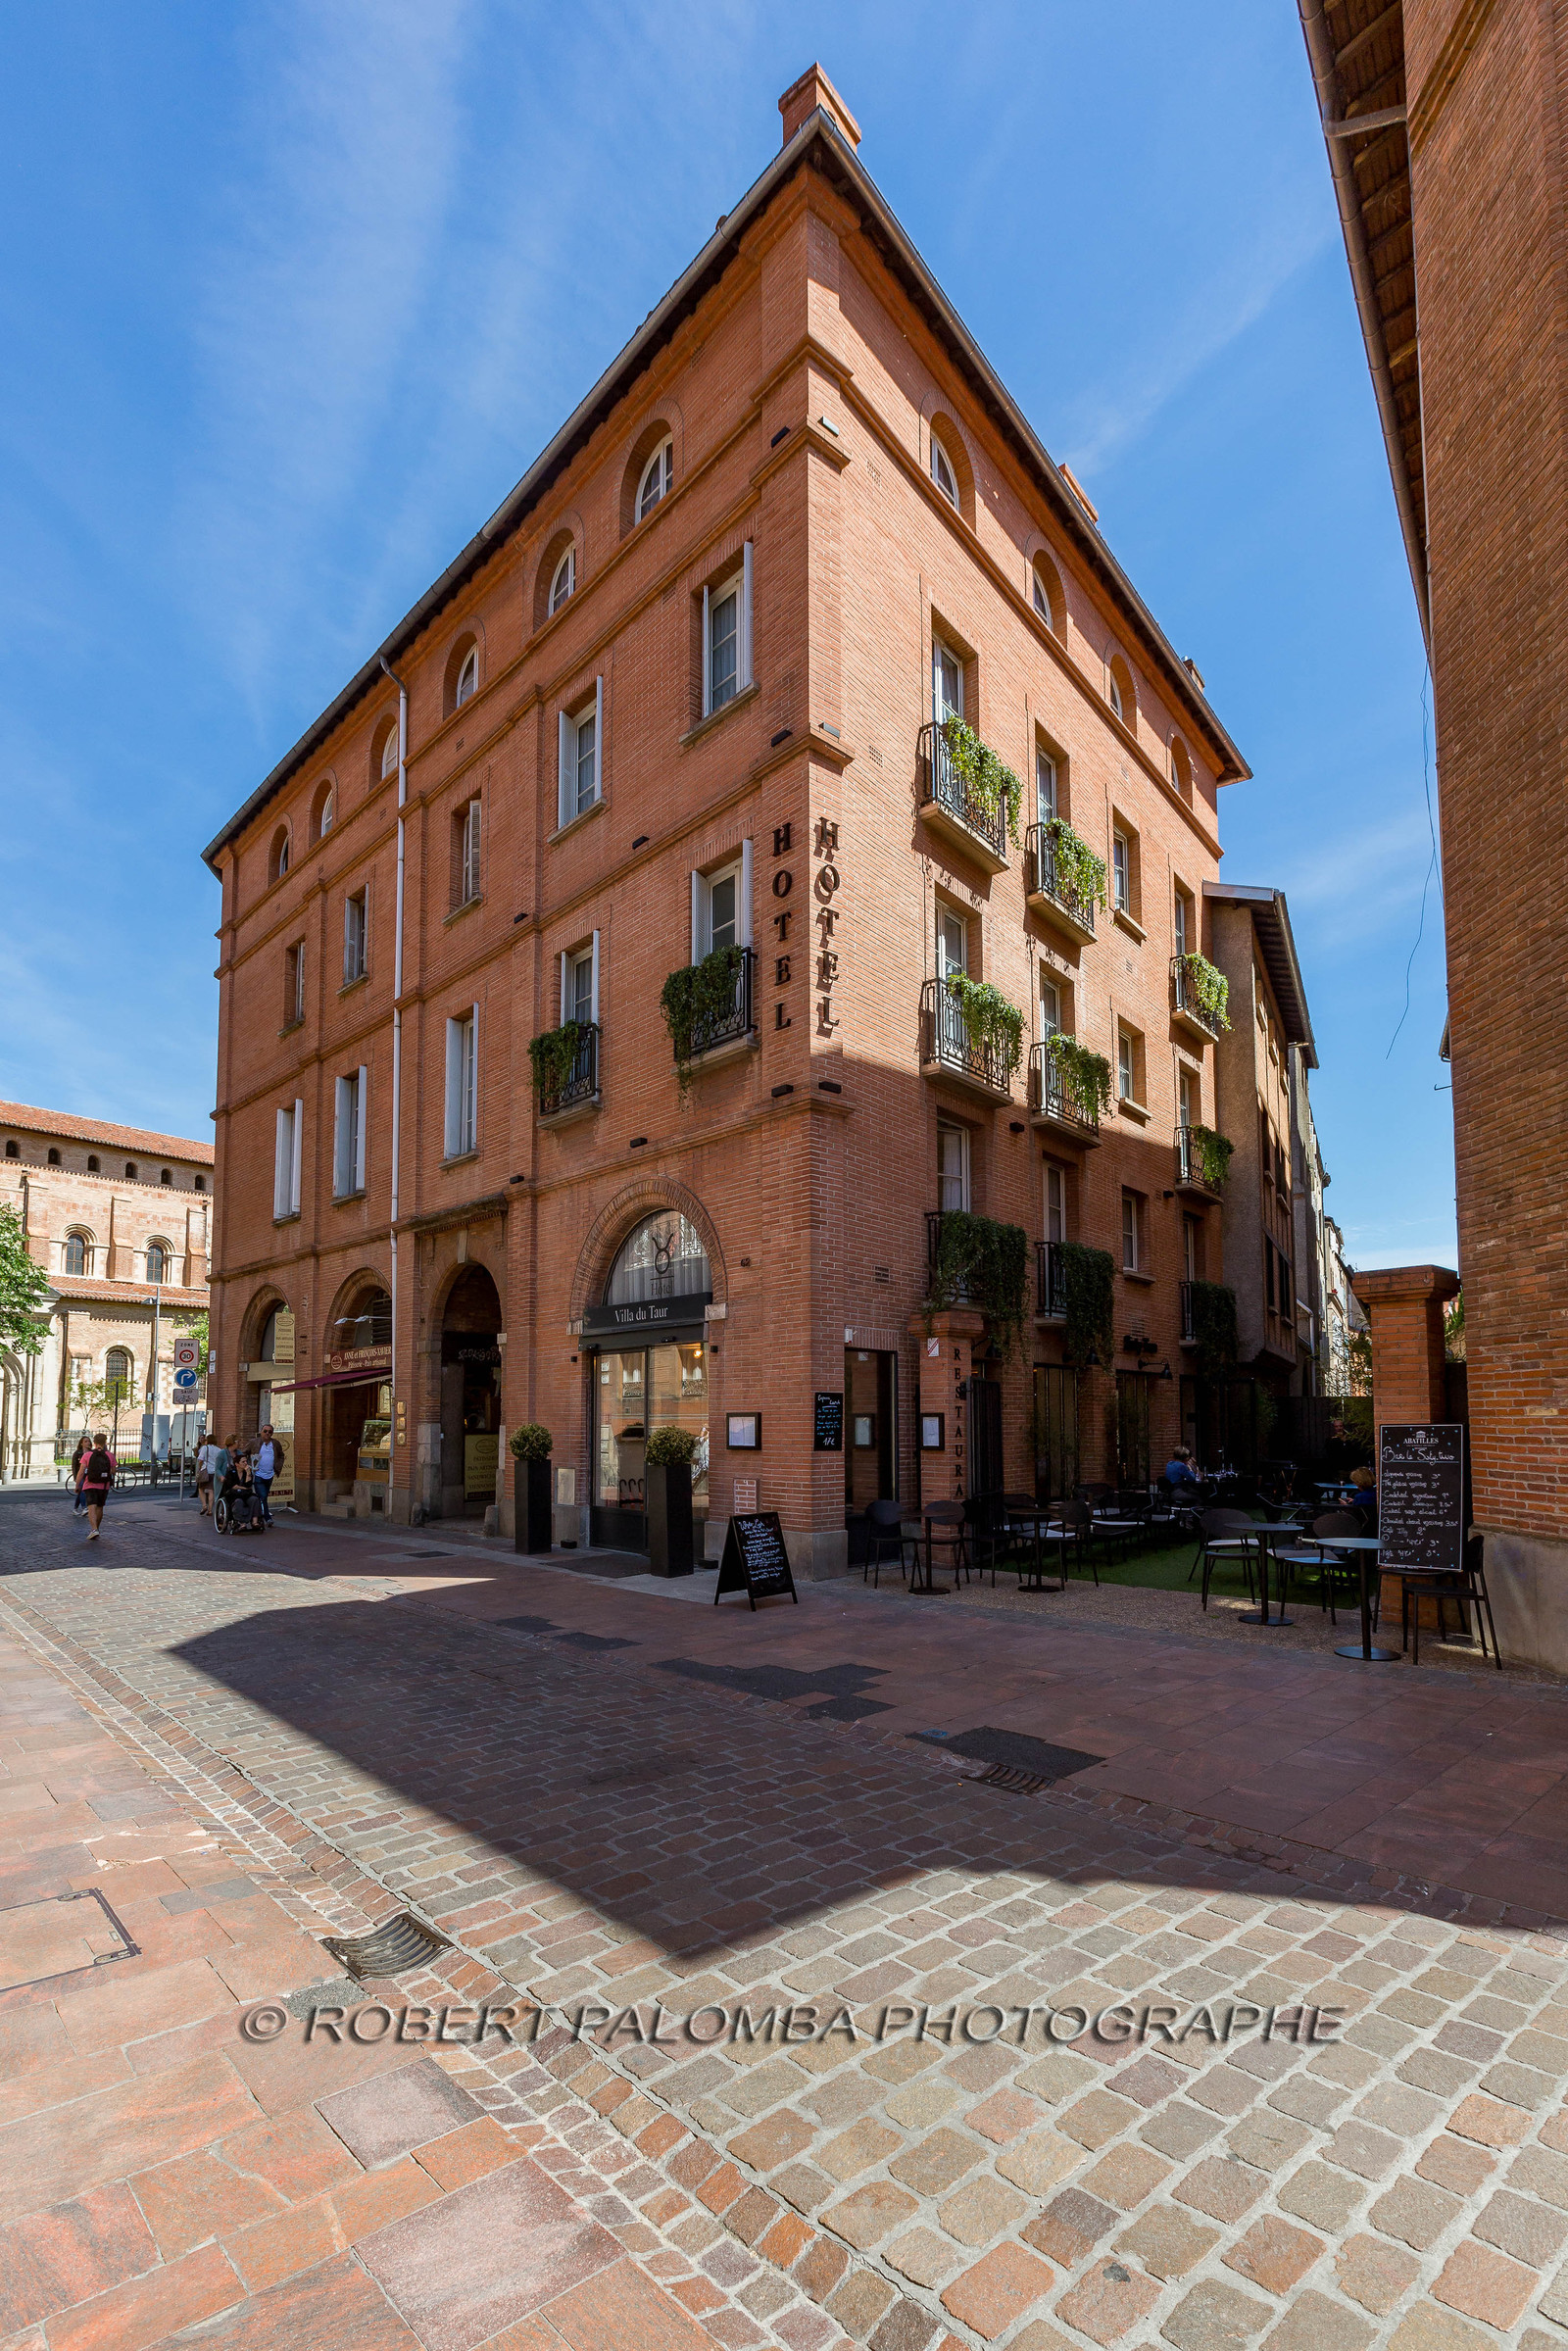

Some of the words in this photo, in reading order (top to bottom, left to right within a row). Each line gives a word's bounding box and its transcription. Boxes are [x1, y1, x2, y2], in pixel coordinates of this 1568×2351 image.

[772, 822, 792, 1030] HOTEL
[818, 817, 840, 1027] HOTEL
[614, 1307, 634, 1322] Villa
[636, 1306, 647, 1320] du
[648, 1304, 668, 1319] Taur
[740, 1257, 752, 1267] 62
